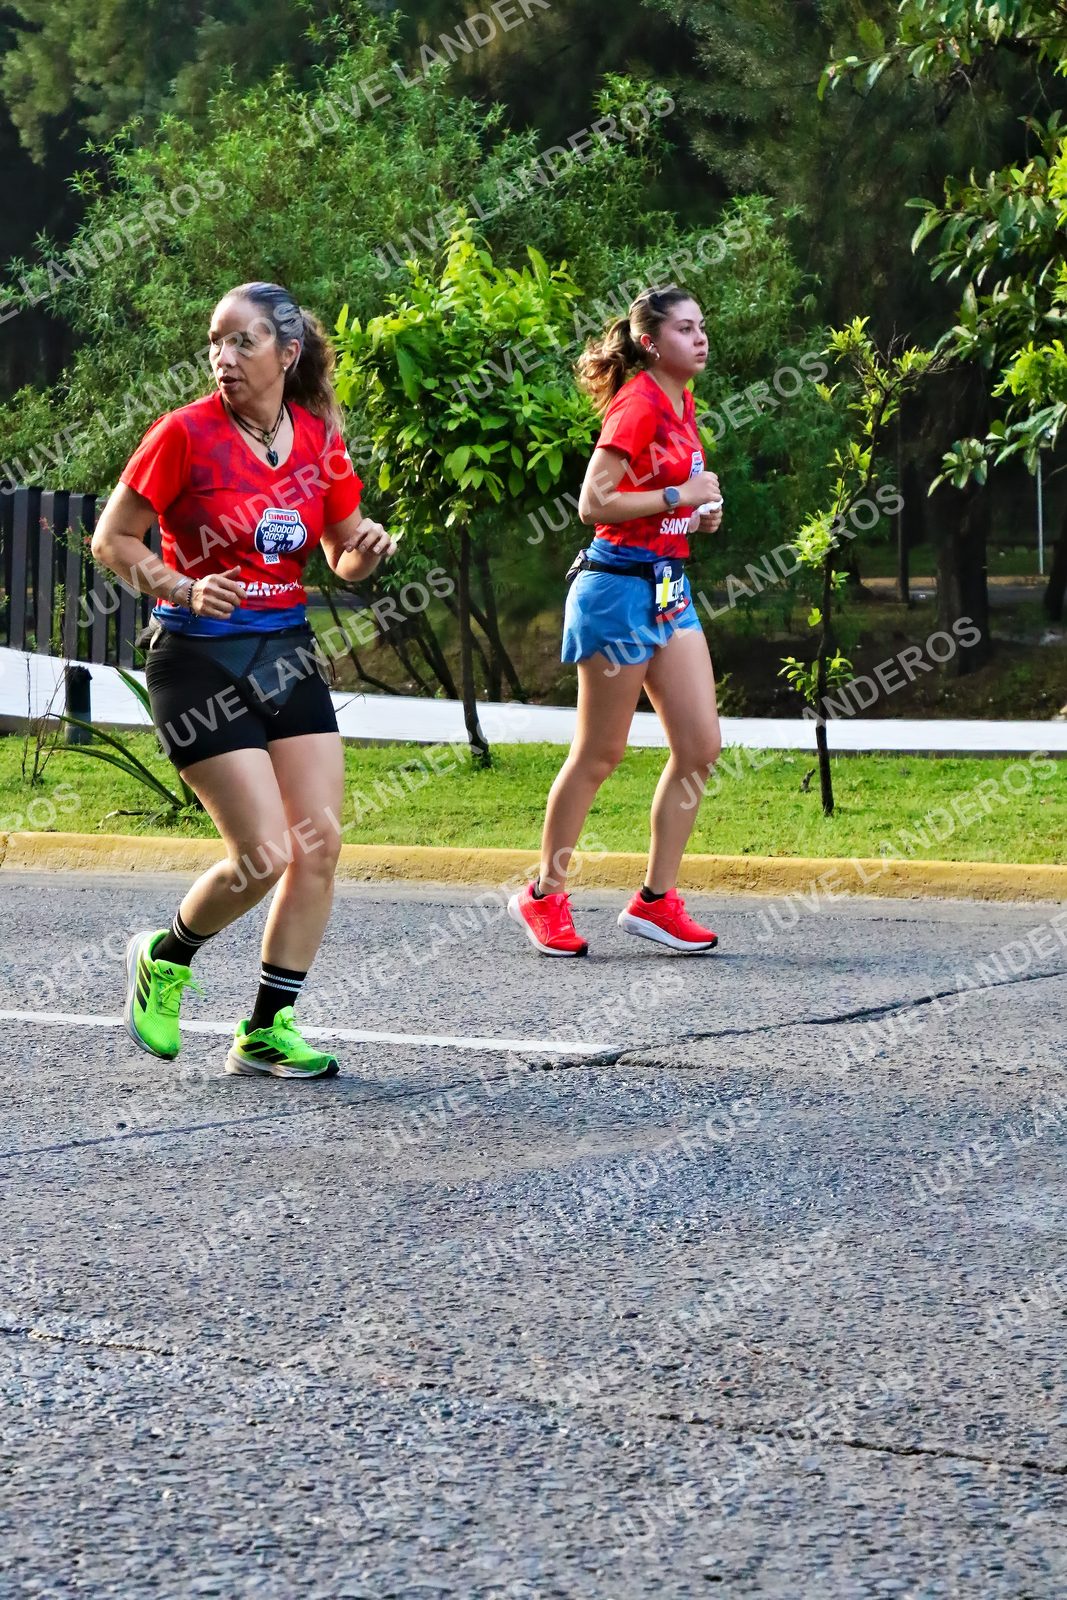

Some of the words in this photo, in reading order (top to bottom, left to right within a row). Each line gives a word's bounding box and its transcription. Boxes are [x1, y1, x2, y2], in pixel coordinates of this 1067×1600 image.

[268, 513, 296, 522] BIMBO
[269, 523, 296, 535] Global
[262, 531, 285, 541] Race
